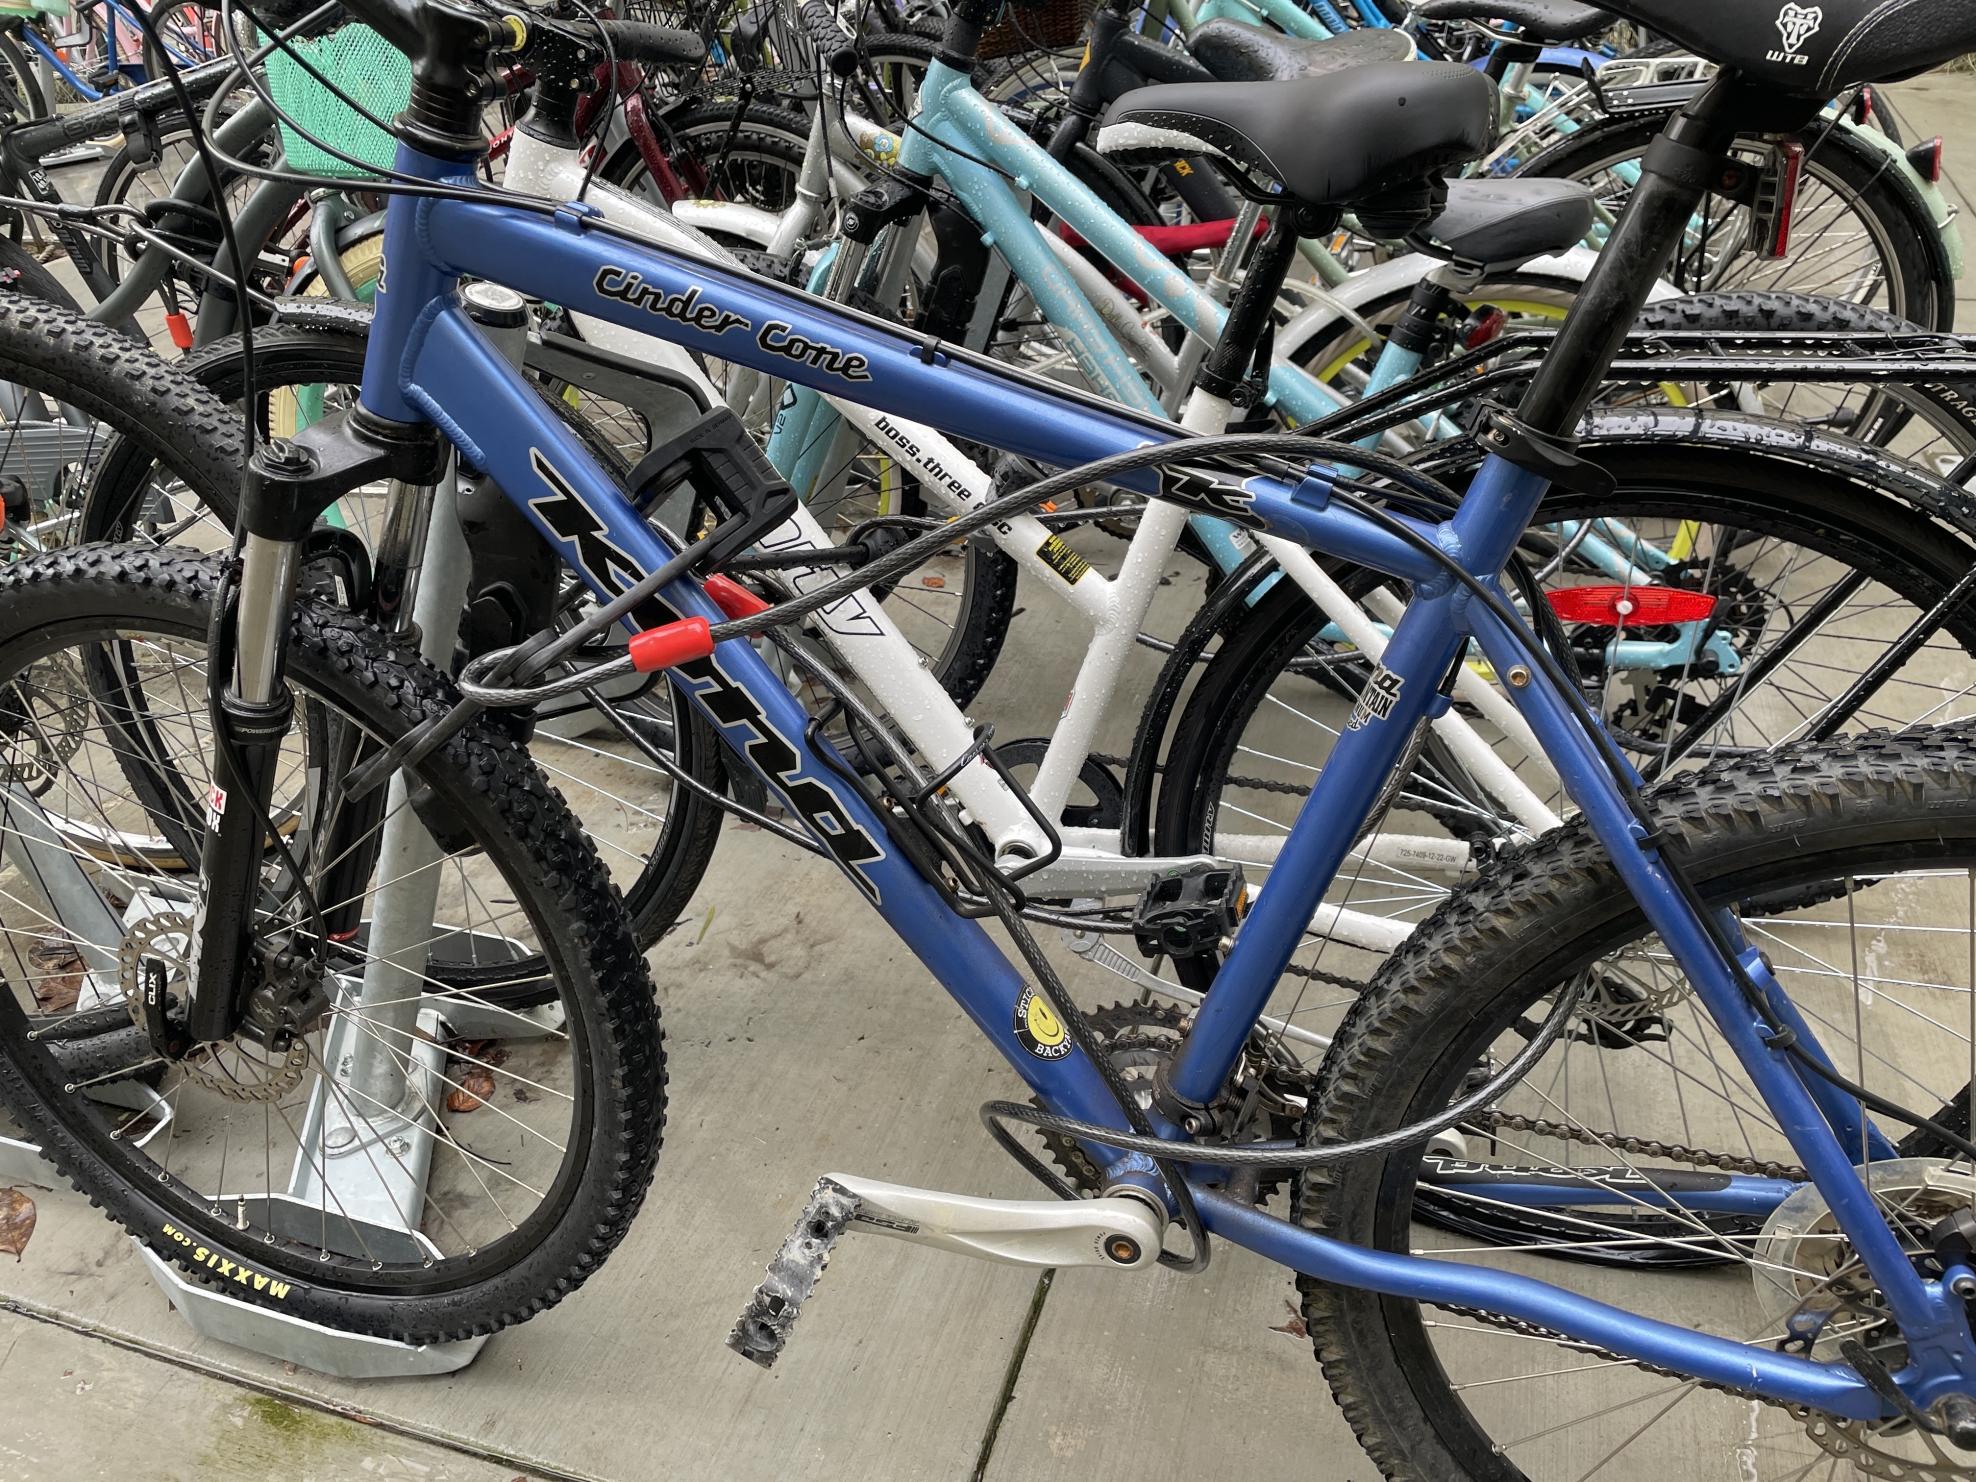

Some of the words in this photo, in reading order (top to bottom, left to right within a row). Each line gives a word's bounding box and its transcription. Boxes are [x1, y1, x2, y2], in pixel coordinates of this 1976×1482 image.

[1765, 50, 1809, 65] WTB
[592, 264, 752, 336] Cinder
[755, 319, 873, 382] Cone
[774, 413, 787, 435] V2
[874, 415, 973, 502] boss.three
[148, 972, 158, 1006] CLIX
